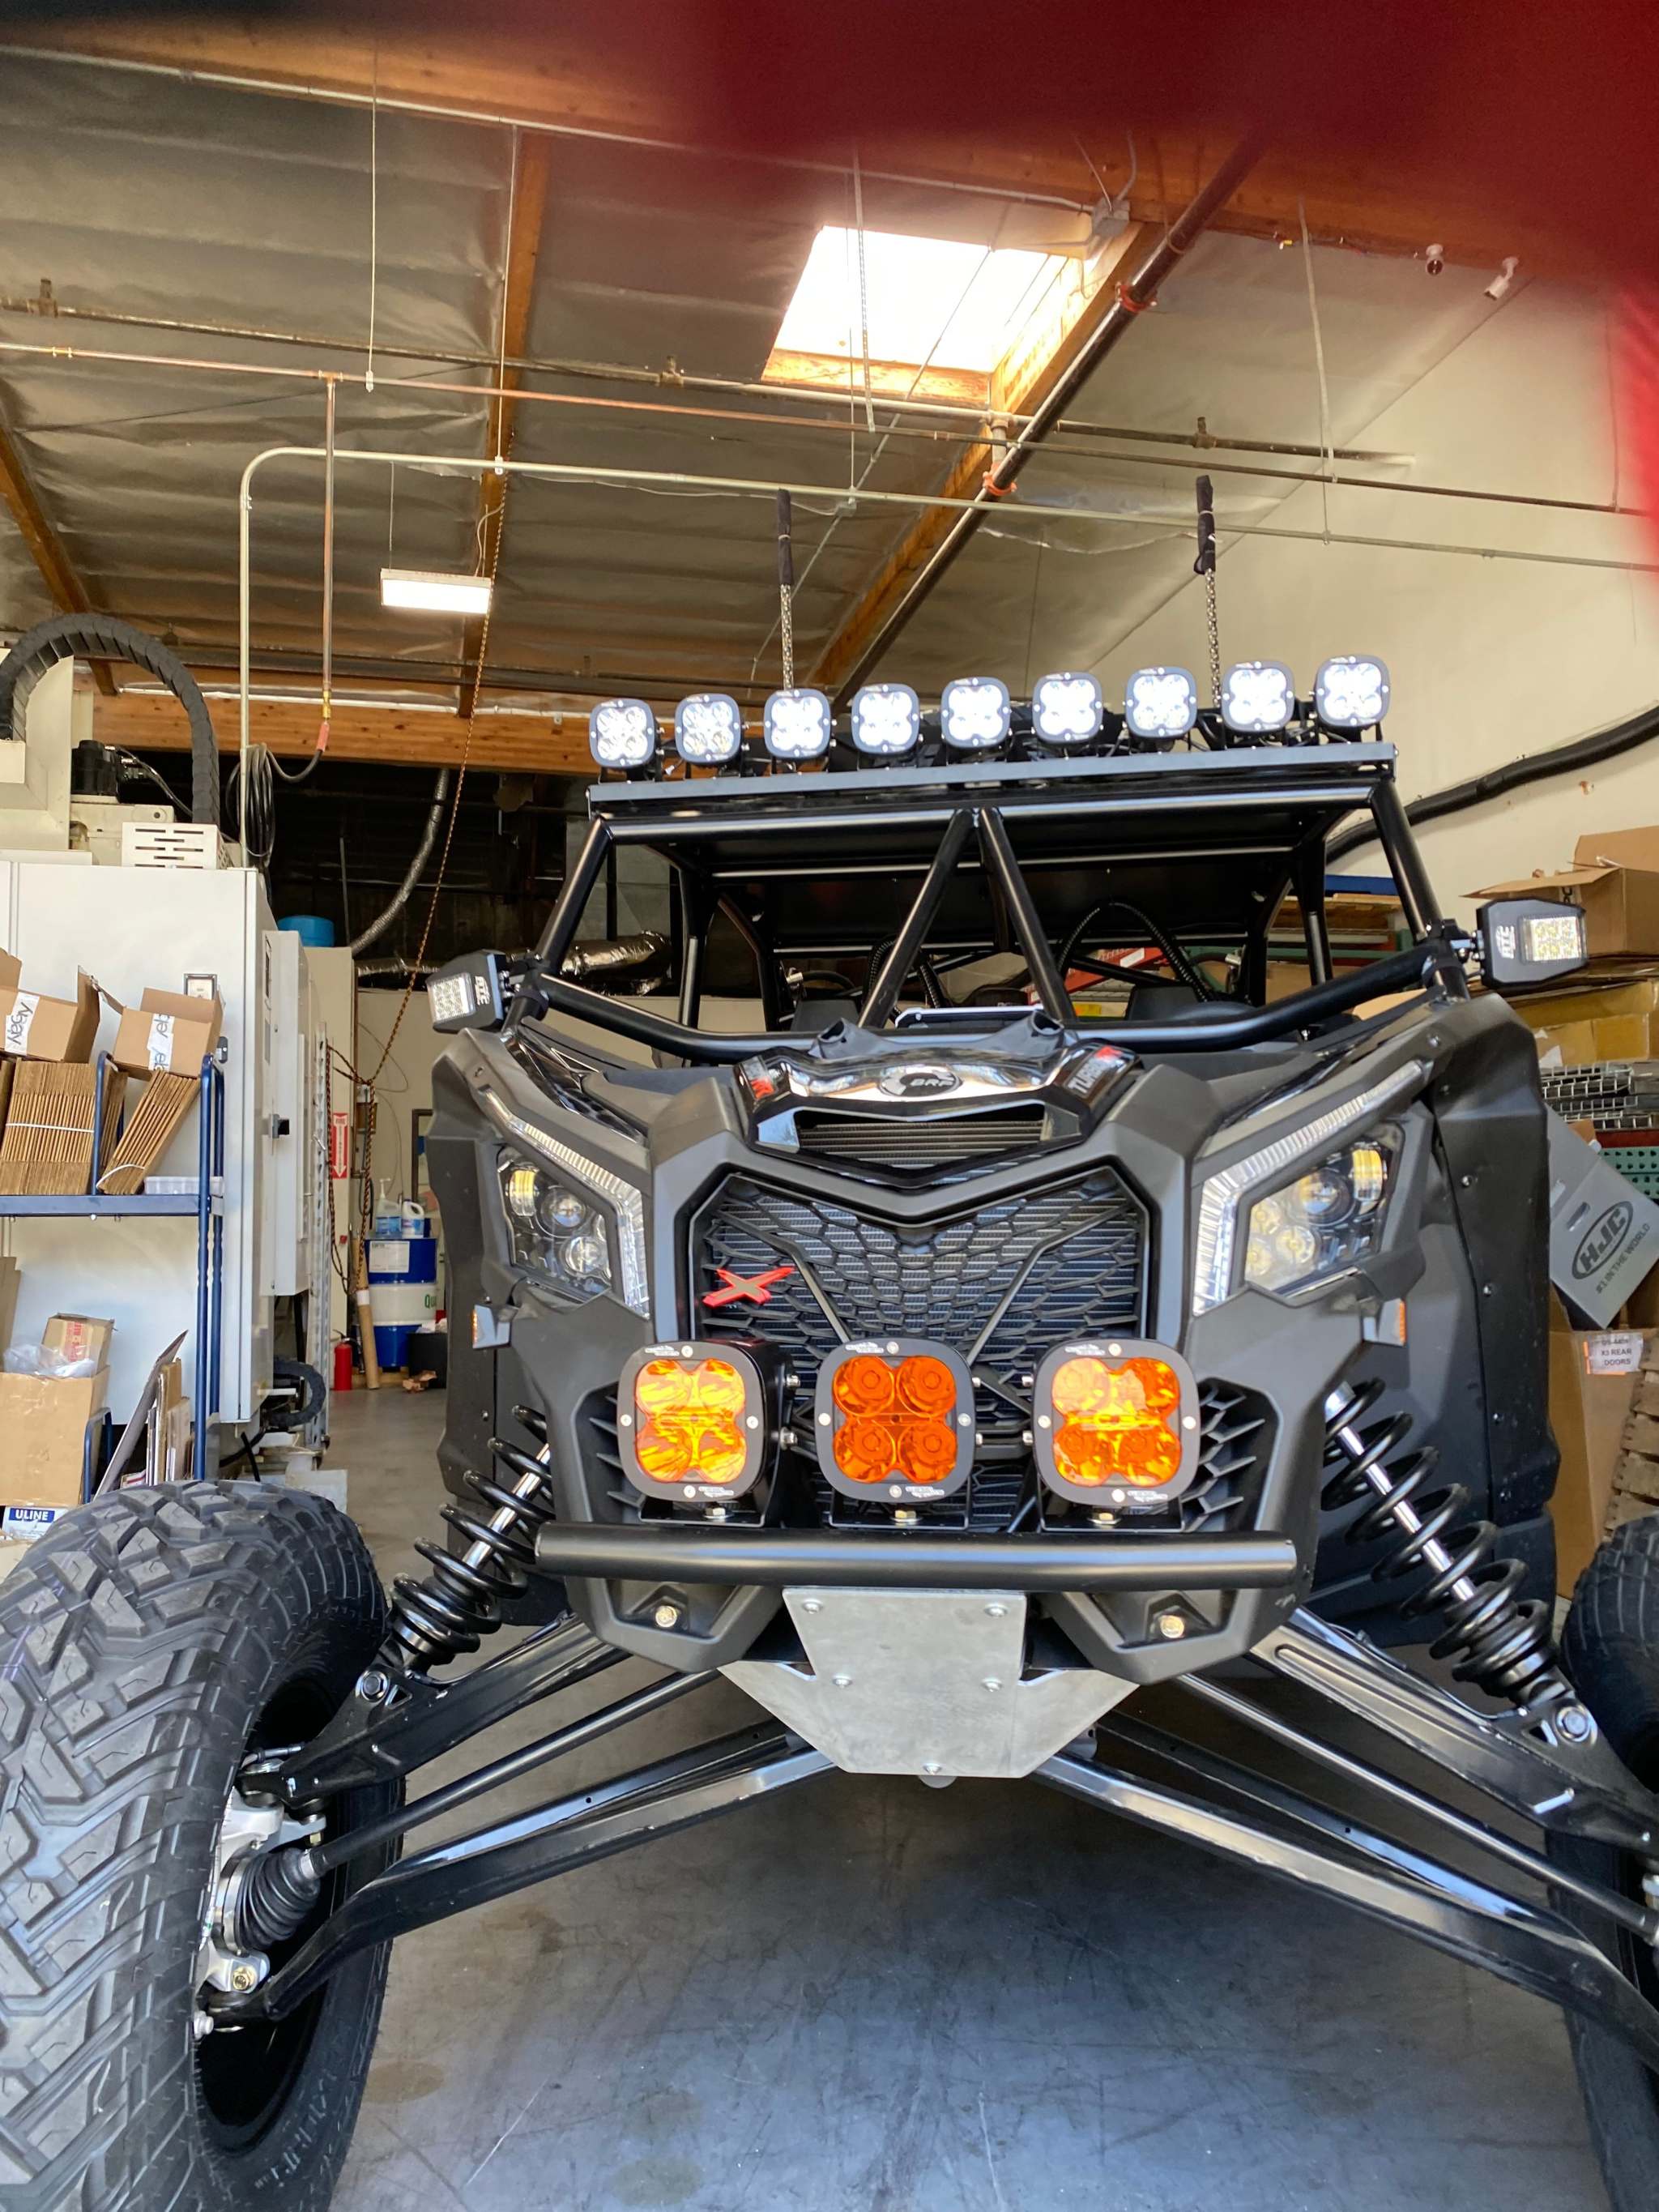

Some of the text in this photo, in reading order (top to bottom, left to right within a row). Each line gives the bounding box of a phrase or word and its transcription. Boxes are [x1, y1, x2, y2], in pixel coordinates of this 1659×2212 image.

[910, 1078, 954, 1087] BRP
[1580, 1208, 1627, 1272] HJC
[1612, 1254, 1627, 1272] THE
[1624, 1223, 1651, 1255] WORLD
[15, 1509, 49, 1521] ULINE
